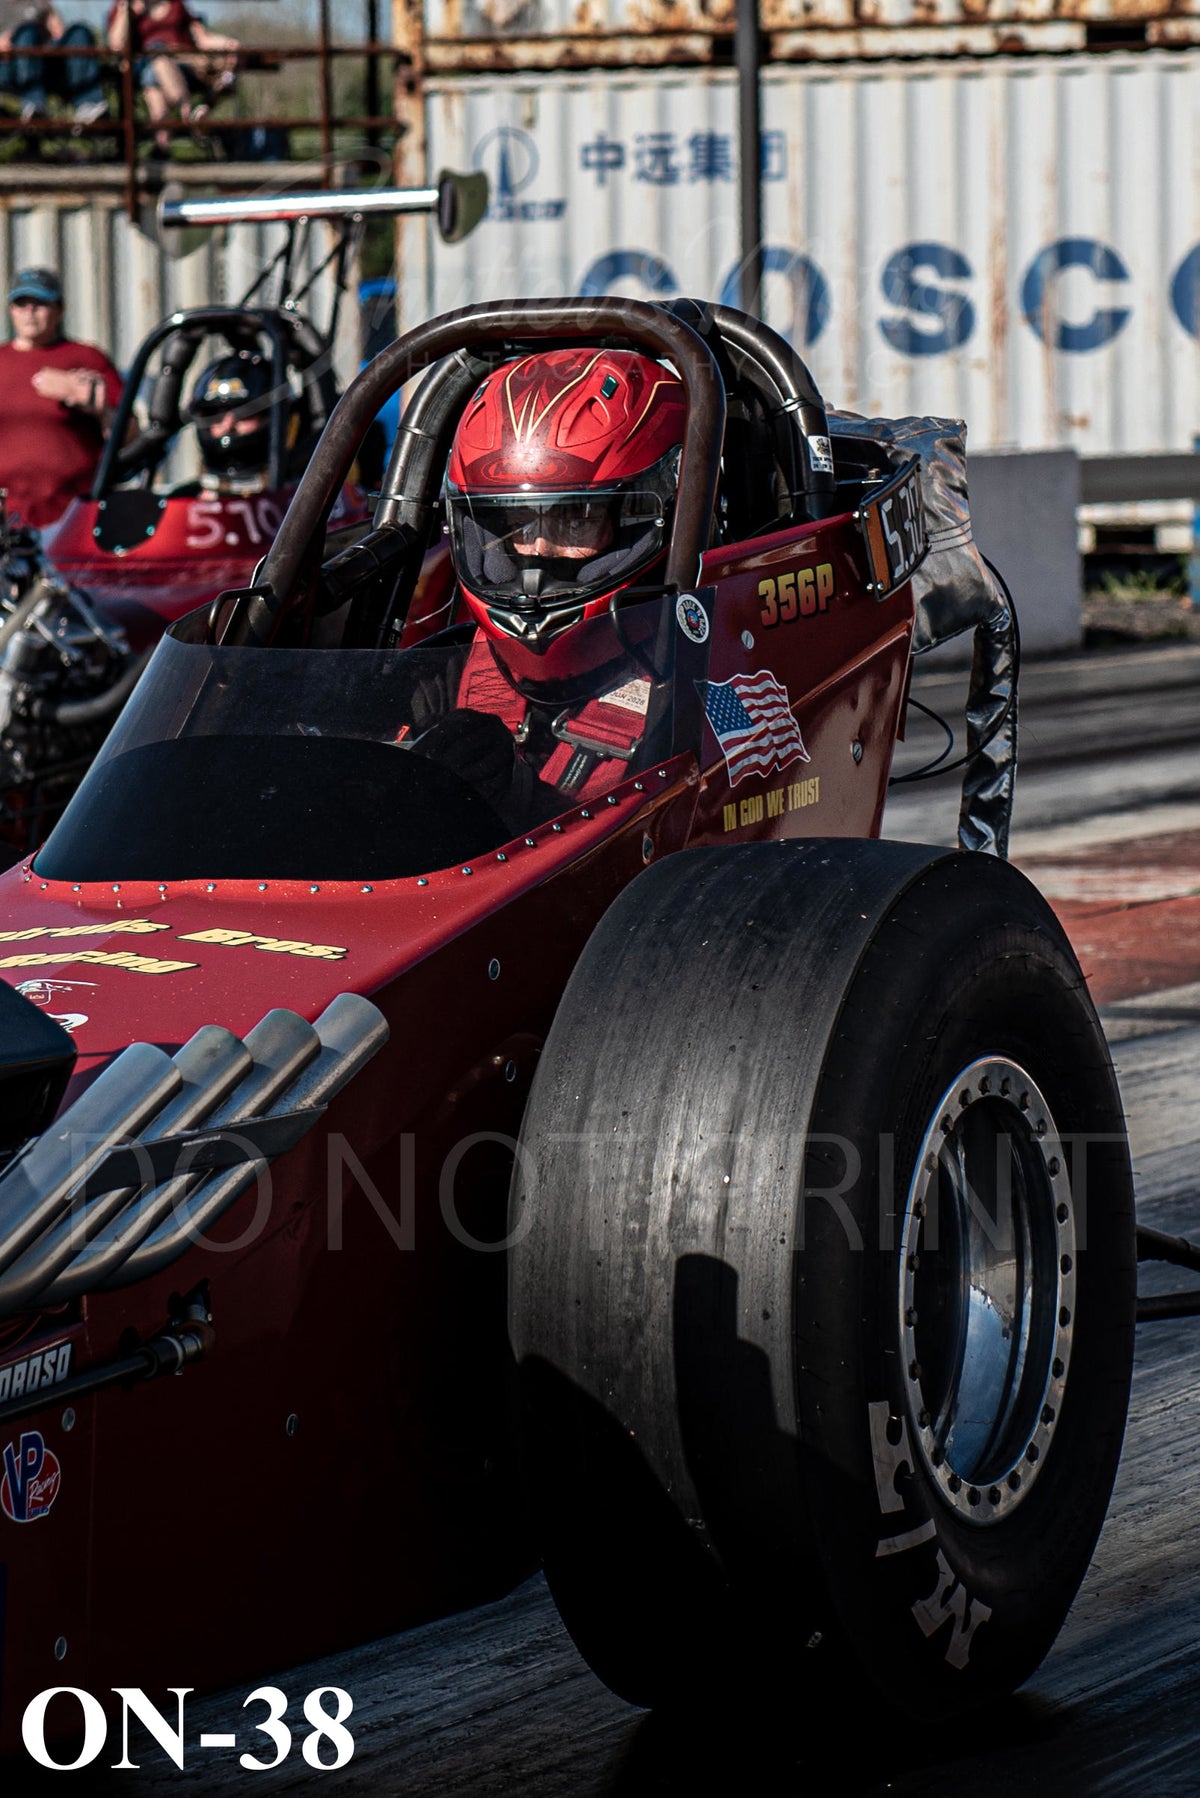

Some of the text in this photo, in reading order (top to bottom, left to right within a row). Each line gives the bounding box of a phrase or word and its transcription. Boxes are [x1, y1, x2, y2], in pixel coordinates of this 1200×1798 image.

[758, 563, 834, 627] 356P
[723, 776, 820, 832] IN GOD WE TRUST
[176, 927, 348, 960] Bros.
[3, 1430, 45, 1521] VP
